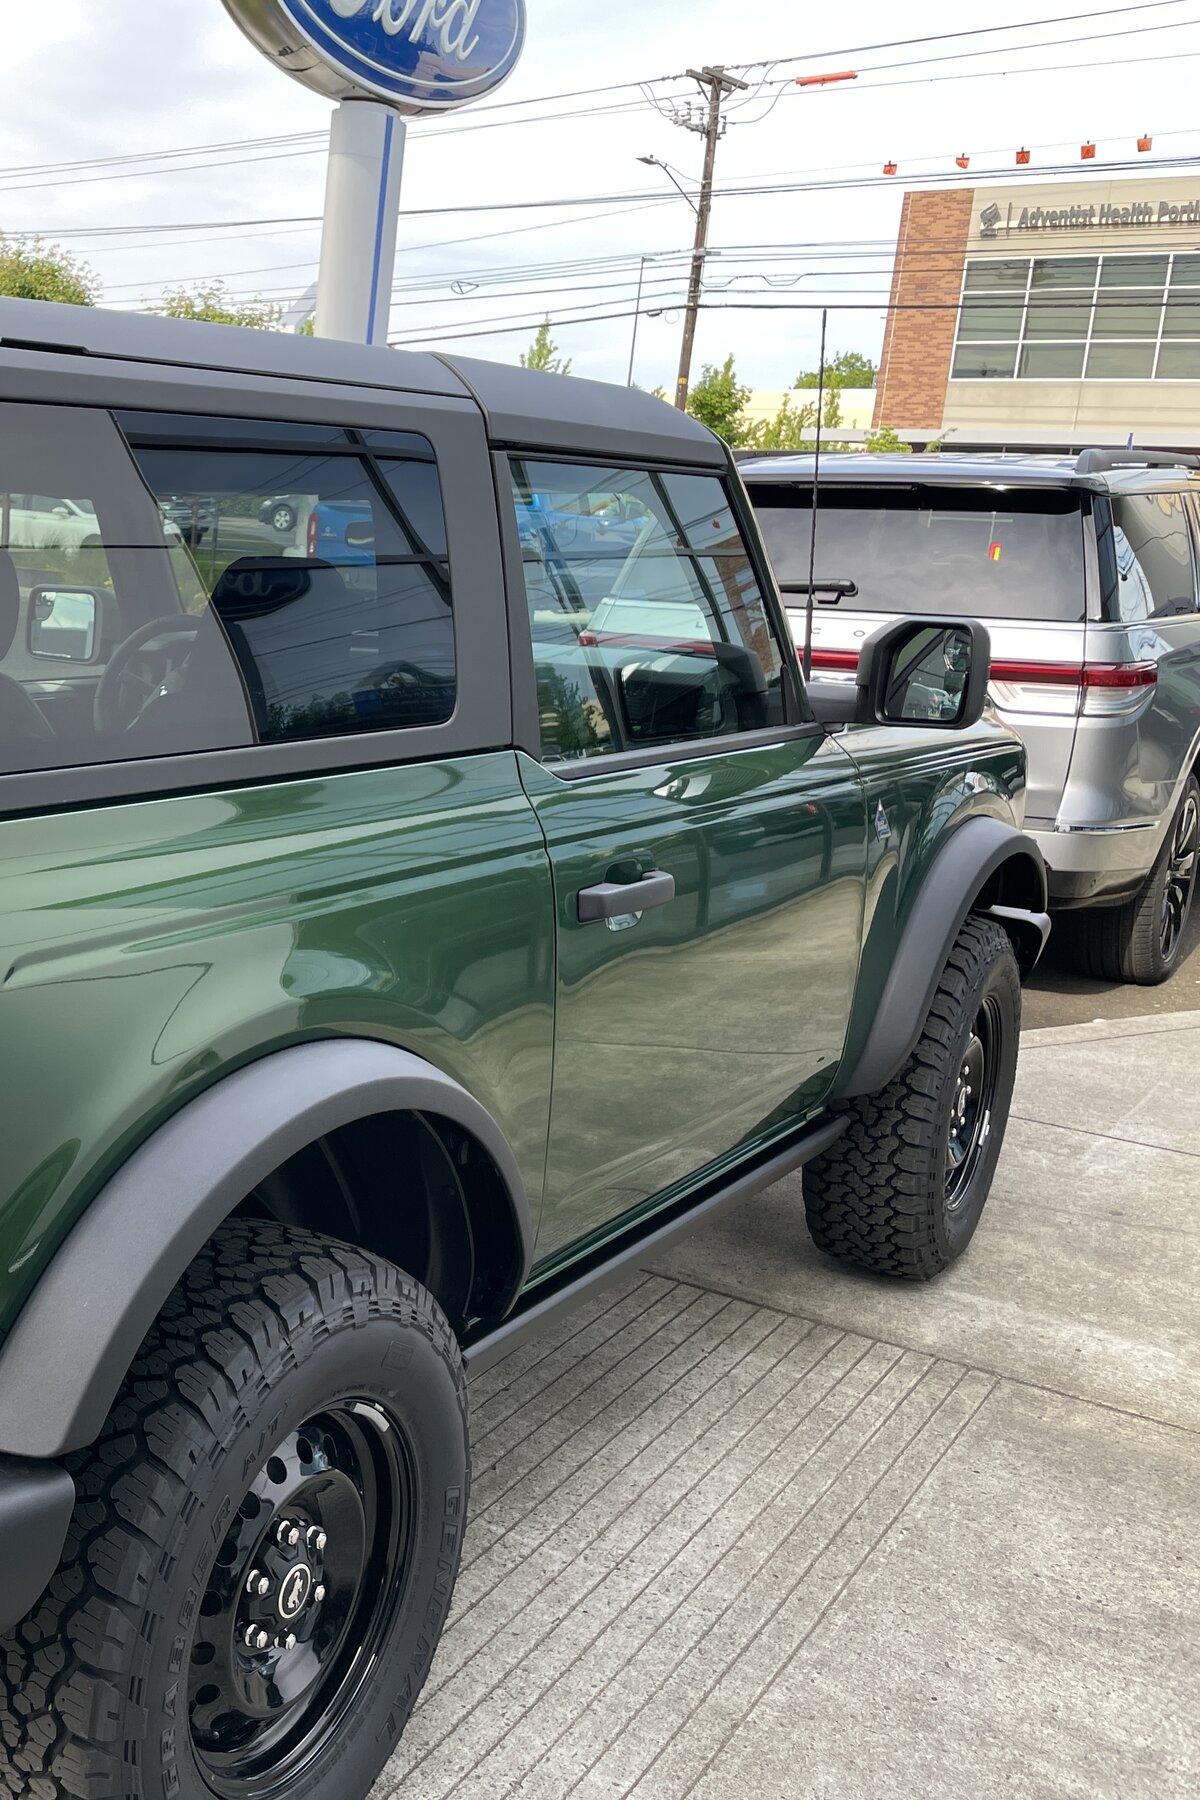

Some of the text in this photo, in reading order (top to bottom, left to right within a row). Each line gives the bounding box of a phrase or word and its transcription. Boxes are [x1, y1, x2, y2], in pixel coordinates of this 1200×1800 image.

[330, 0, 479, 61] ord
[1018, 204, 1096, 232] Adventist
[1099, 202, 1153, 229] Health
[161, 1494, 230, 1799] GRABBER
